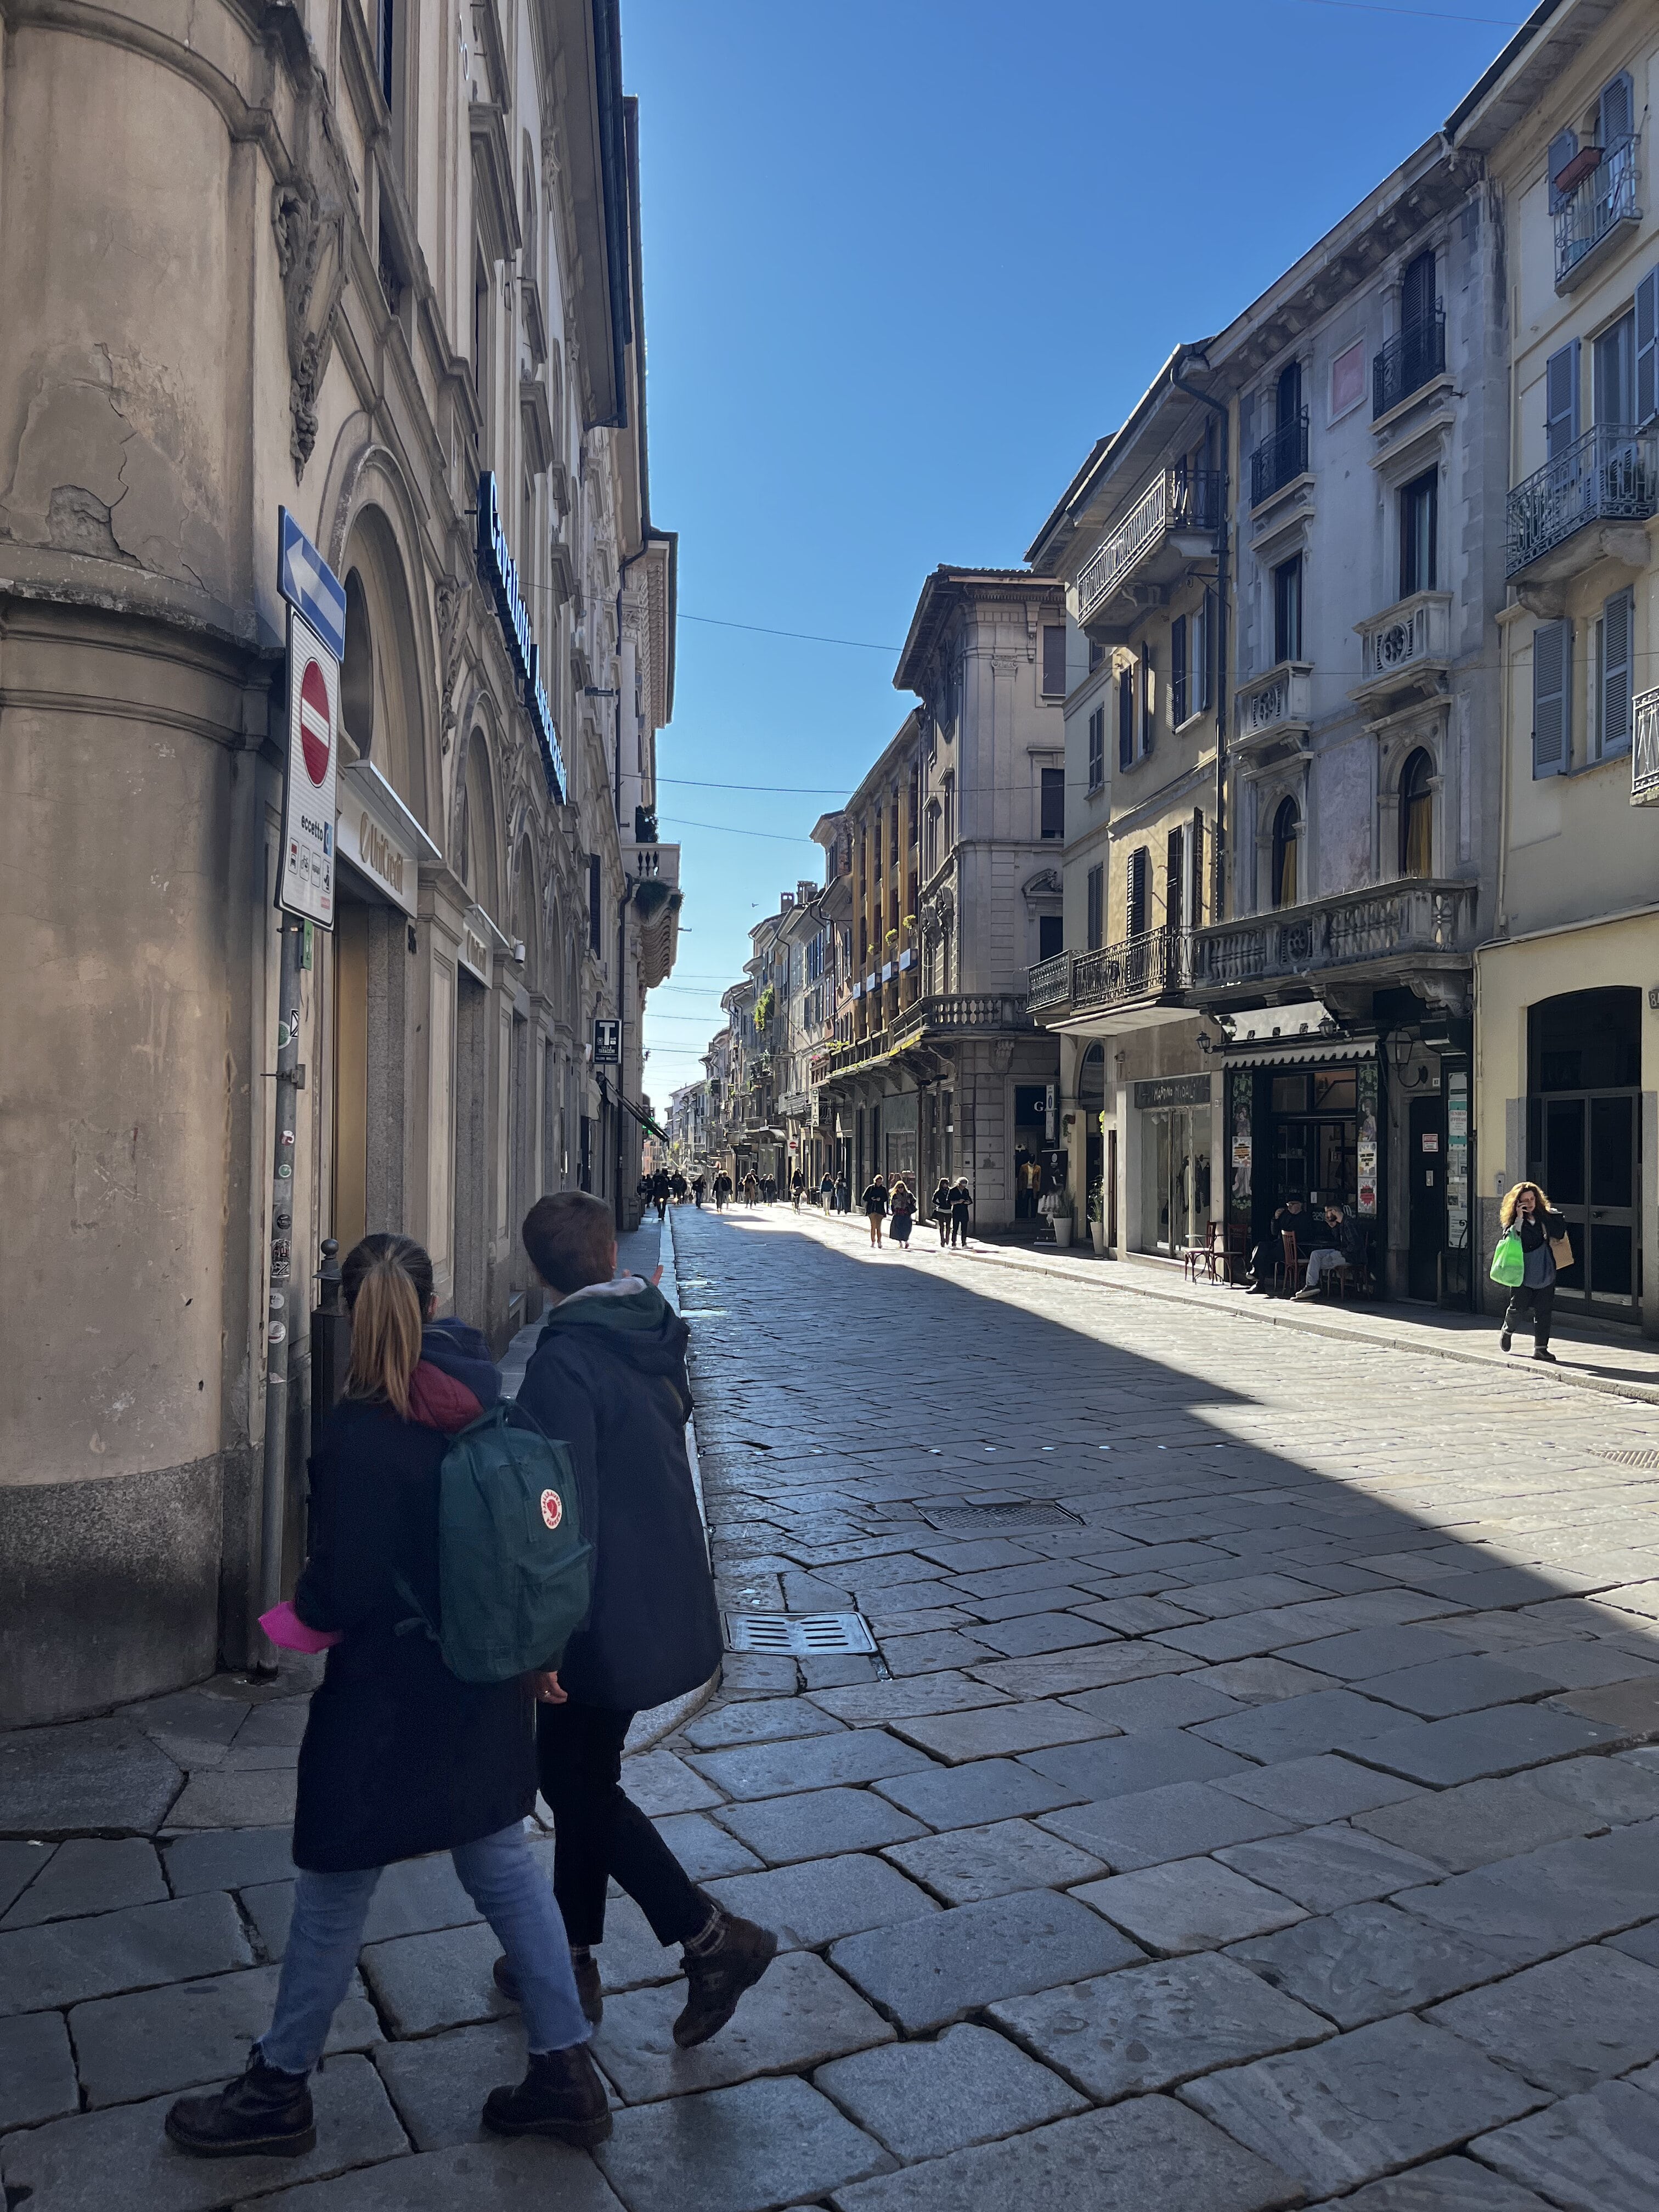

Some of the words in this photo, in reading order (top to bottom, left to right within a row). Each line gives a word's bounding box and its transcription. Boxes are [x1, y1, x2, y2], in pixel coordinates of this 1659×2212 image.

[302, 815, 323, 841] eccetto
[370, 823, 403, 895] UniCredit
[1650, 993, 1659, 1007] 8
[599, 1022, 615, 1045] T
